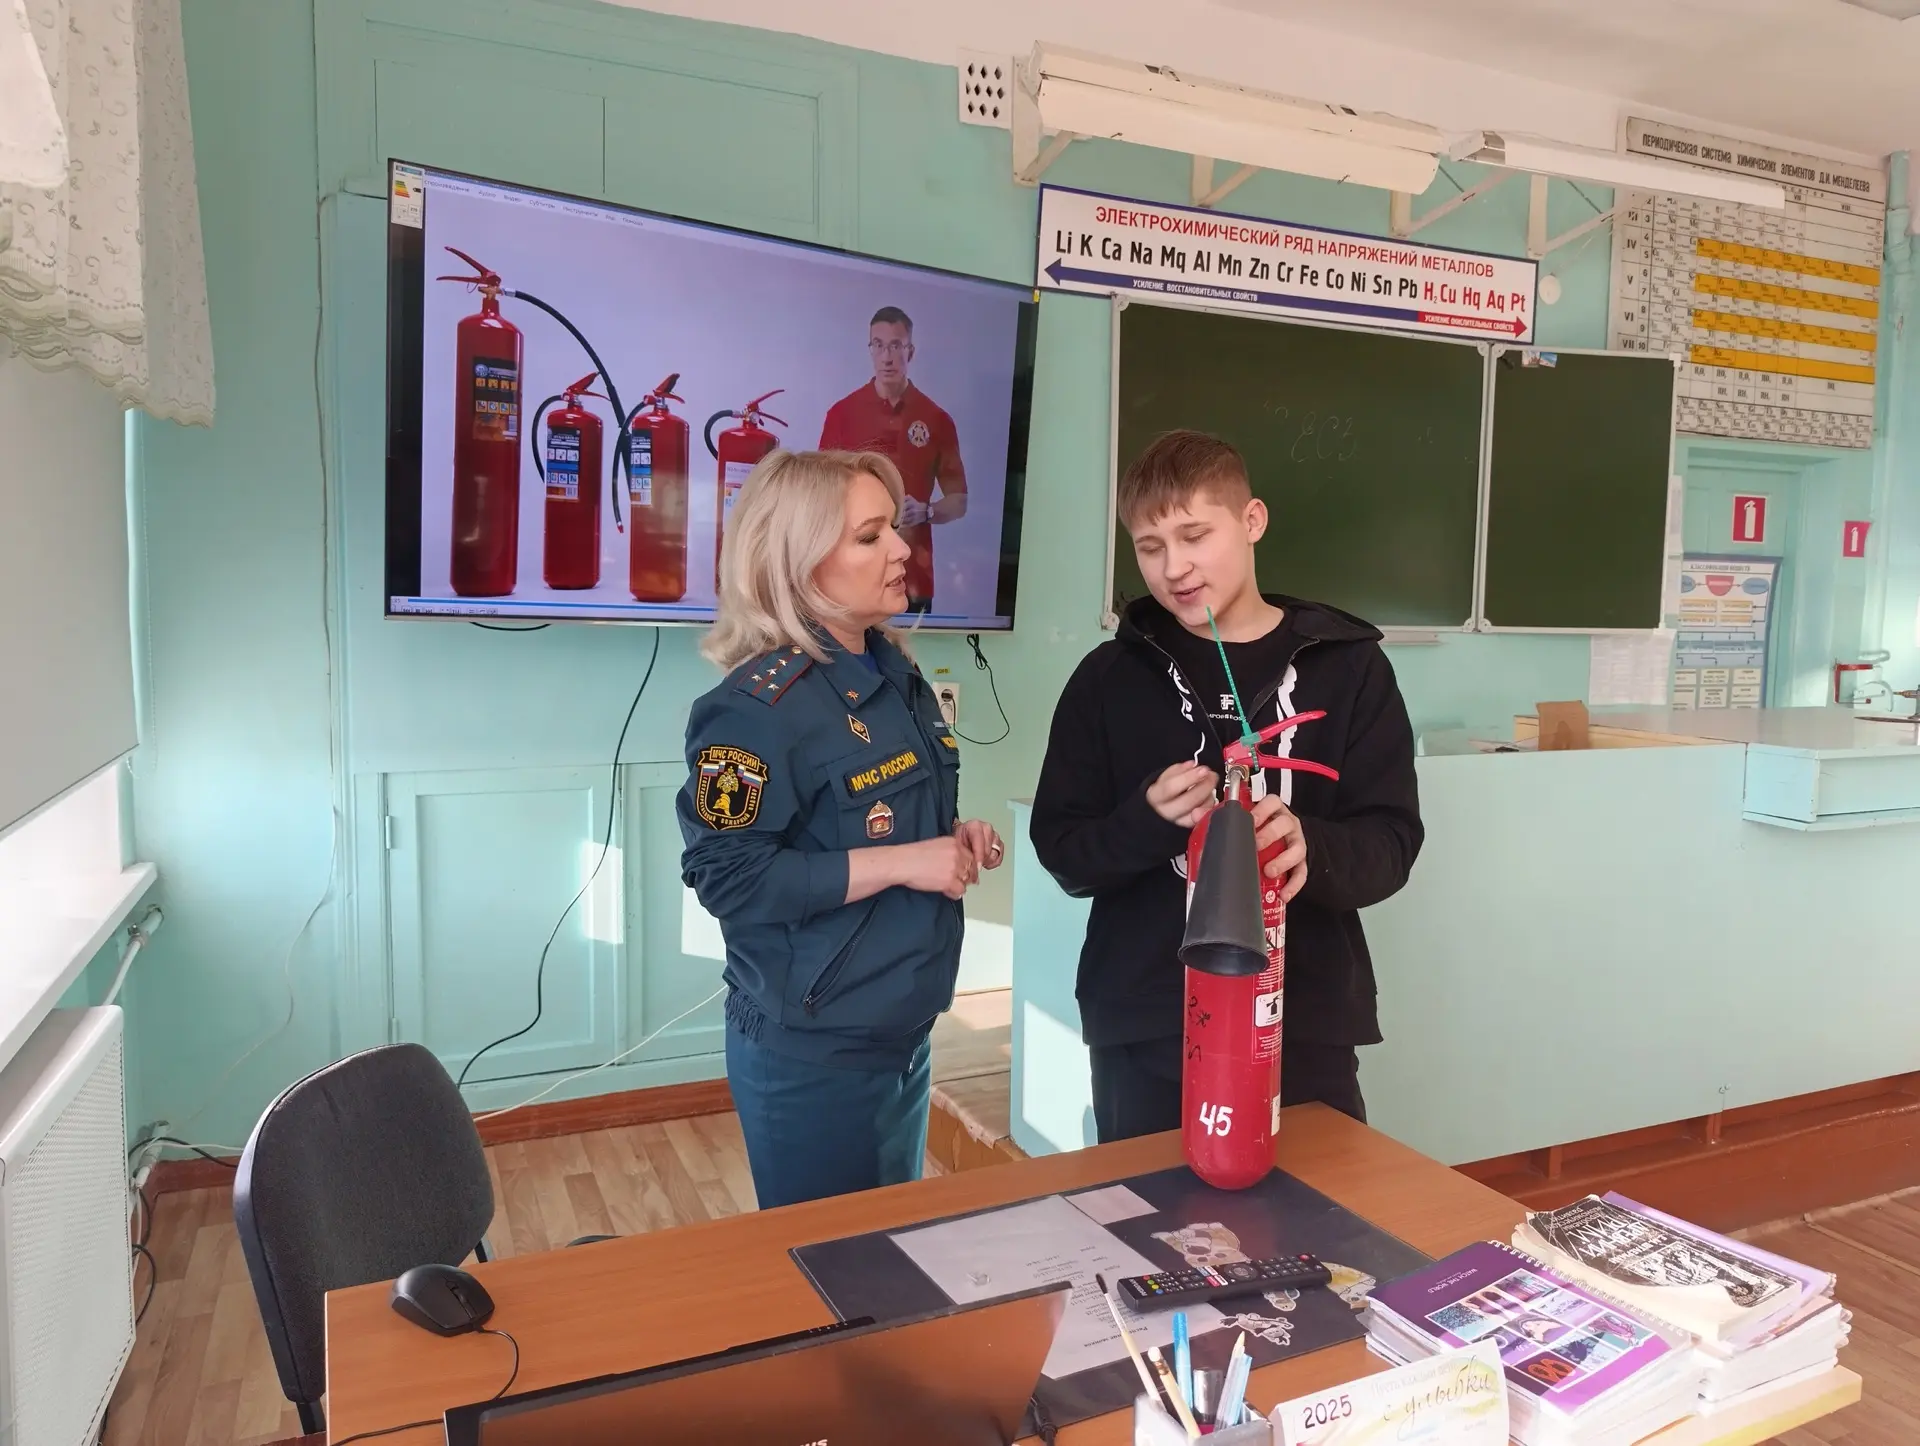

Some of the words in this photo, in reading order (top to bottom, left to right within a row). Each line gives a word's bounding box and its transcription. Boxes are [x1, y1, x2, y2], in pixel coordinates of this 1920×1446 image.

[1781, 163, 1816, 181] ЭЛЕМЕНТОВ
[1096, 206, 1279, 248] ЭЛЕКТРОХИМИЧЕСКИЙ
[1284, 235, 1314, 255] РЯД
[1318, 240, 1418, 267] НАПРЯЖЕНИЙ
[1421, 255, 1494, 278] МЕТАЛЛОВ
[1056, 230, 1072, 254] Li
[1080, 234, 1093, 257] K
[1101, 237, 1122, 261] Ca
[1130, 241, 1152, 265] Na
[1193, 250, 1211, 272] Al
[1218, 253, 1242, 276] Mn
[1249, 257, 1270, 280] Zn
[1277, 261, 1294, 283] Cr
[1300, 264, 1319, 286] Fe
[1326, 268, 1344, 289] Co
[1351, 271, 1366, 292] Ni
[1373, 274, 1392, 296] Sn
[1398, 277, 1418, 299] Pb
[1440, 283, 1457, 303] Cu
[1511, 293, 1526, 312] Pt
[1133, 279, 1164, 291] УСИЛЕНИЕ
[1167, 283, 1231, 298] ВОССТАНОВИТЕЛЬНЫХ
[1232, 291, 1258, 302] СВОЙСТВ
[1424, 313, 1450, 325] УСИЛЕНИЕ
[712, 749, 727, 759] МЧС
[727, 750, 758, 768] РОССИИ
[851, 769, 880, 791] МЧС
[879, 751, 918, 780] РОССИИ
[1199, 1101, 1233, 1137] 45
[1579, 1220, 1650, 1258] ДРЕВНИЙ
[1428, 1283, 1448, 1293] WORLD
[1303, 1394, 1353, 1430] 2025
